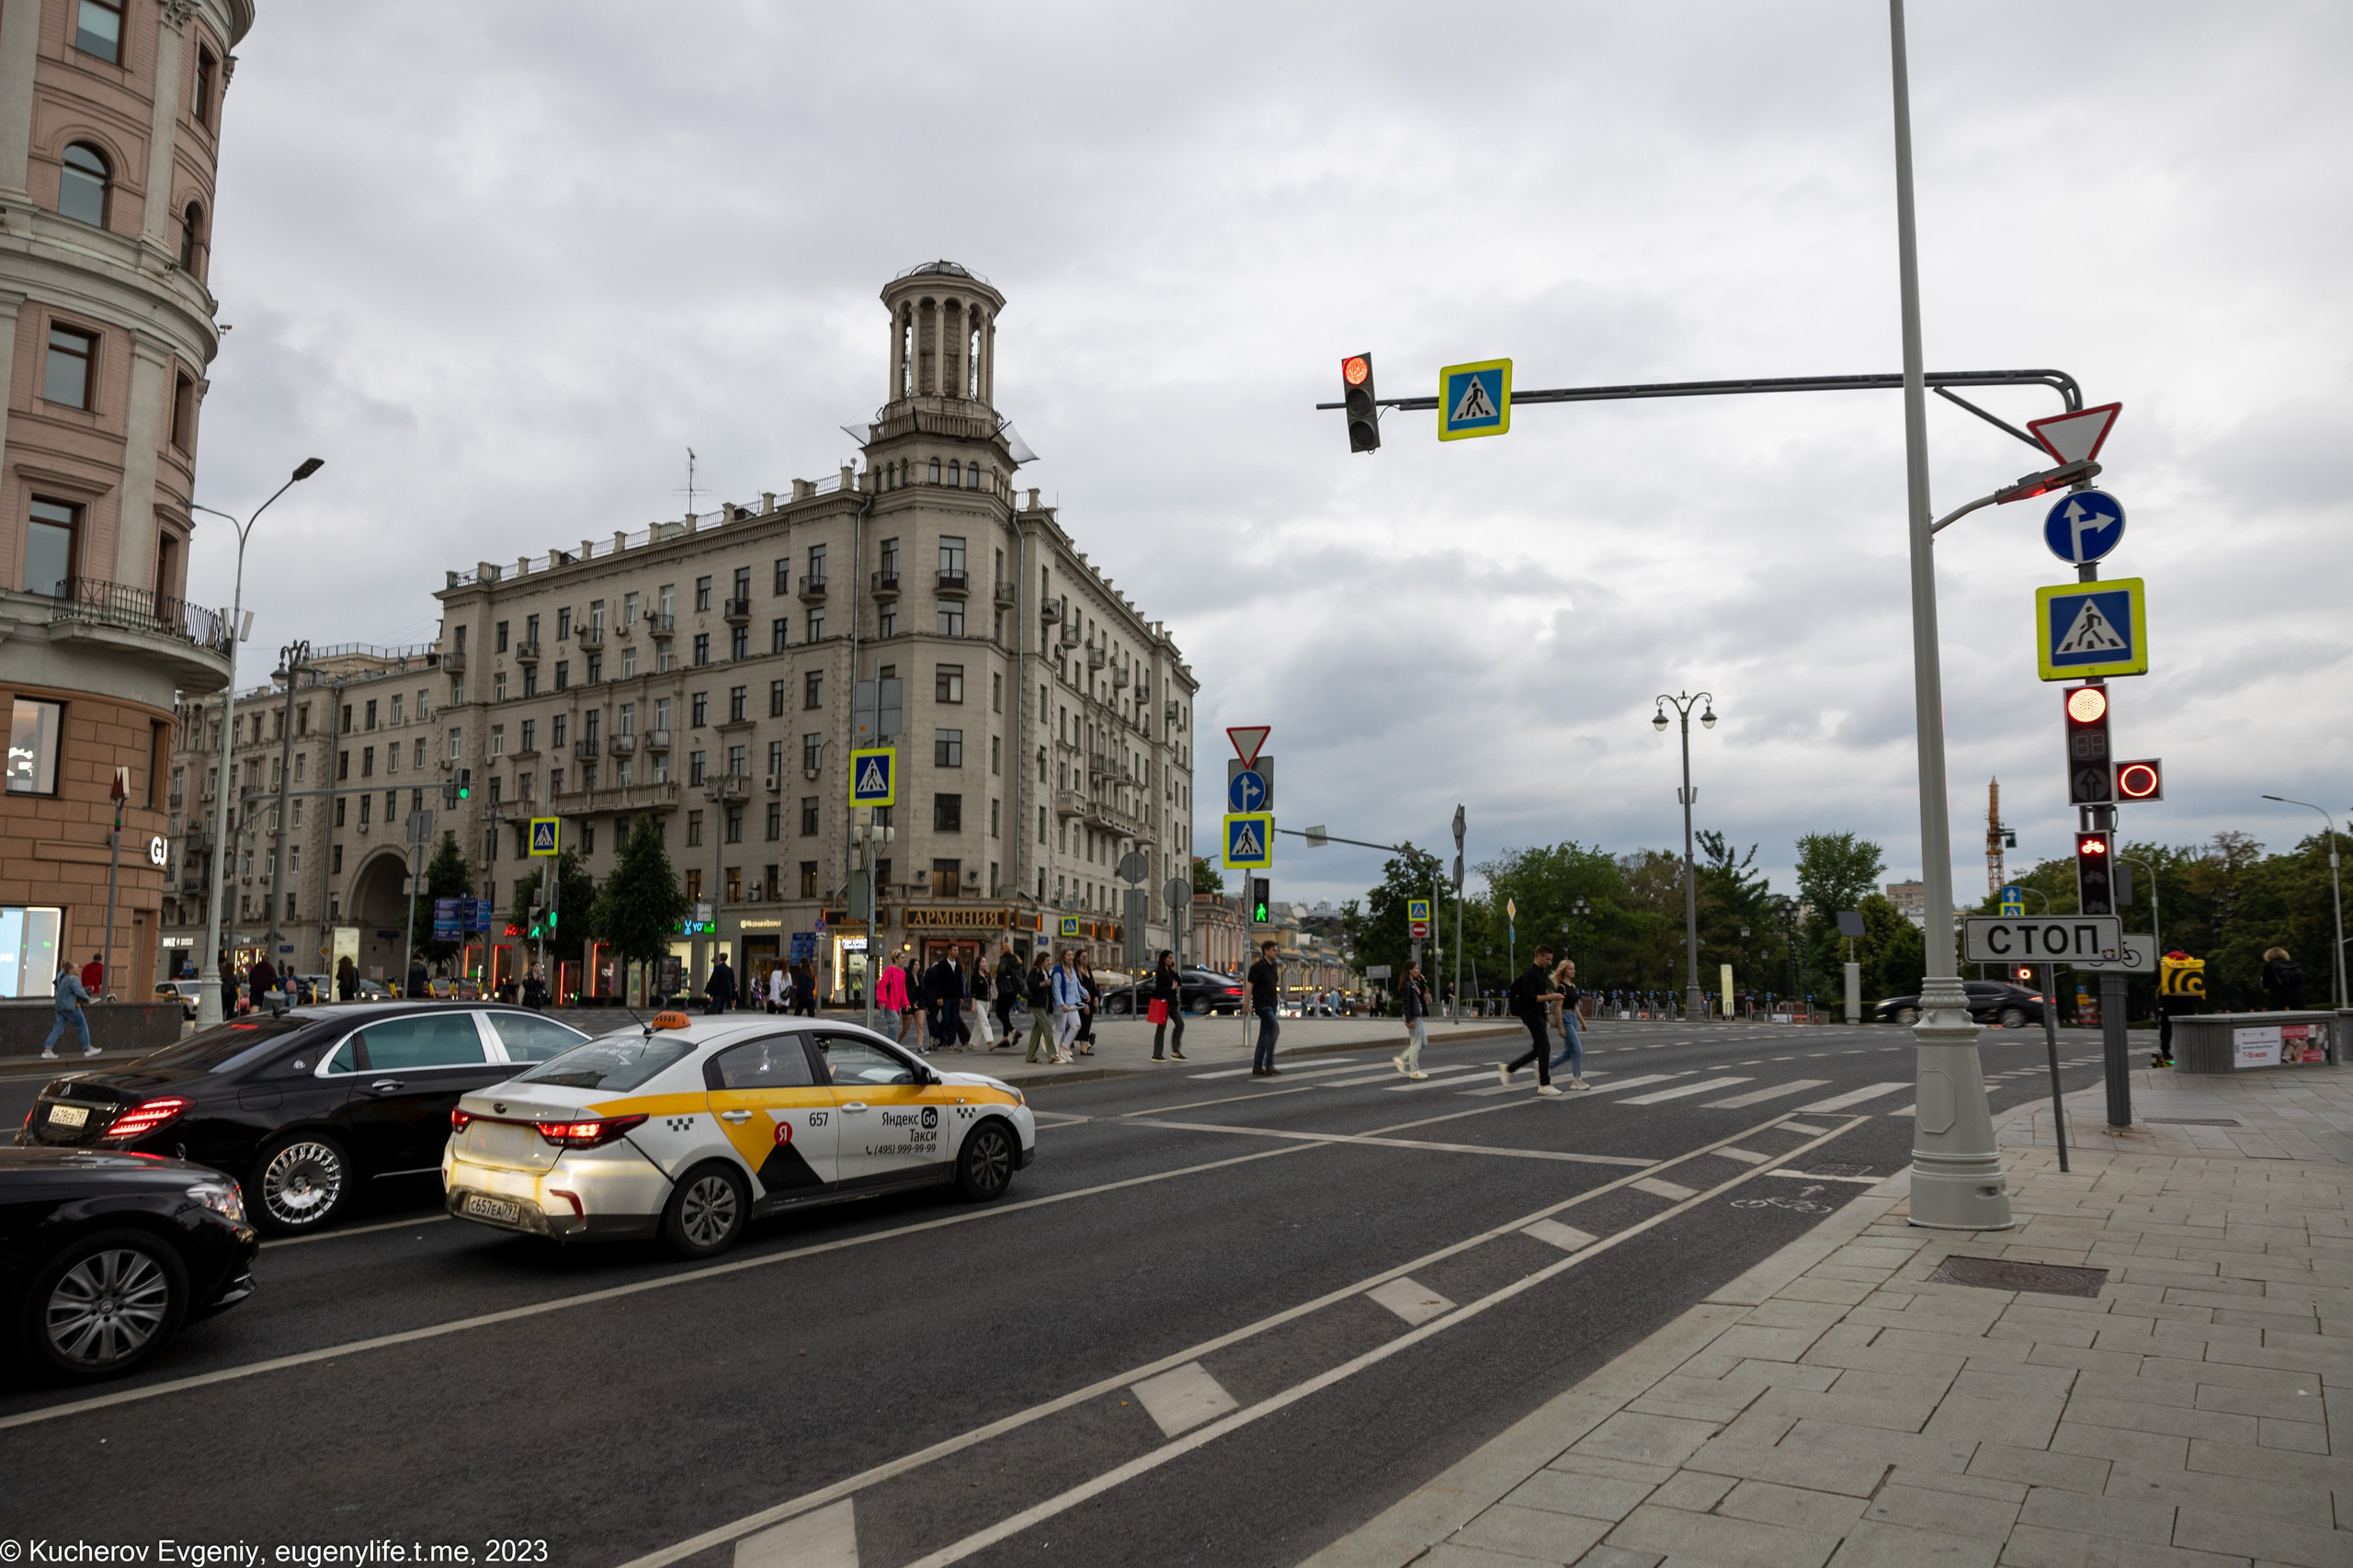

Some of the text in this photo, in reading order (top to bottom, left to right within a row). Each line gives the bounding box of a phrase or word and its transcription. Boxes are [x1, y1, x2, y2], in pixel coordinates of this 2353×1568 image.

[151, 835, 168, 866] GJ
[914, 911, 999, 926] АРМЕНИЯ
[1987, 924, 2098, 955] СТОП
[809, 1112, 829, 1127] 657
[881, 1109, 937, 1128] Яндекс Go
[909, 1128, 938, 1142] Такси
[874, 1144, 895, 1156] (495)
